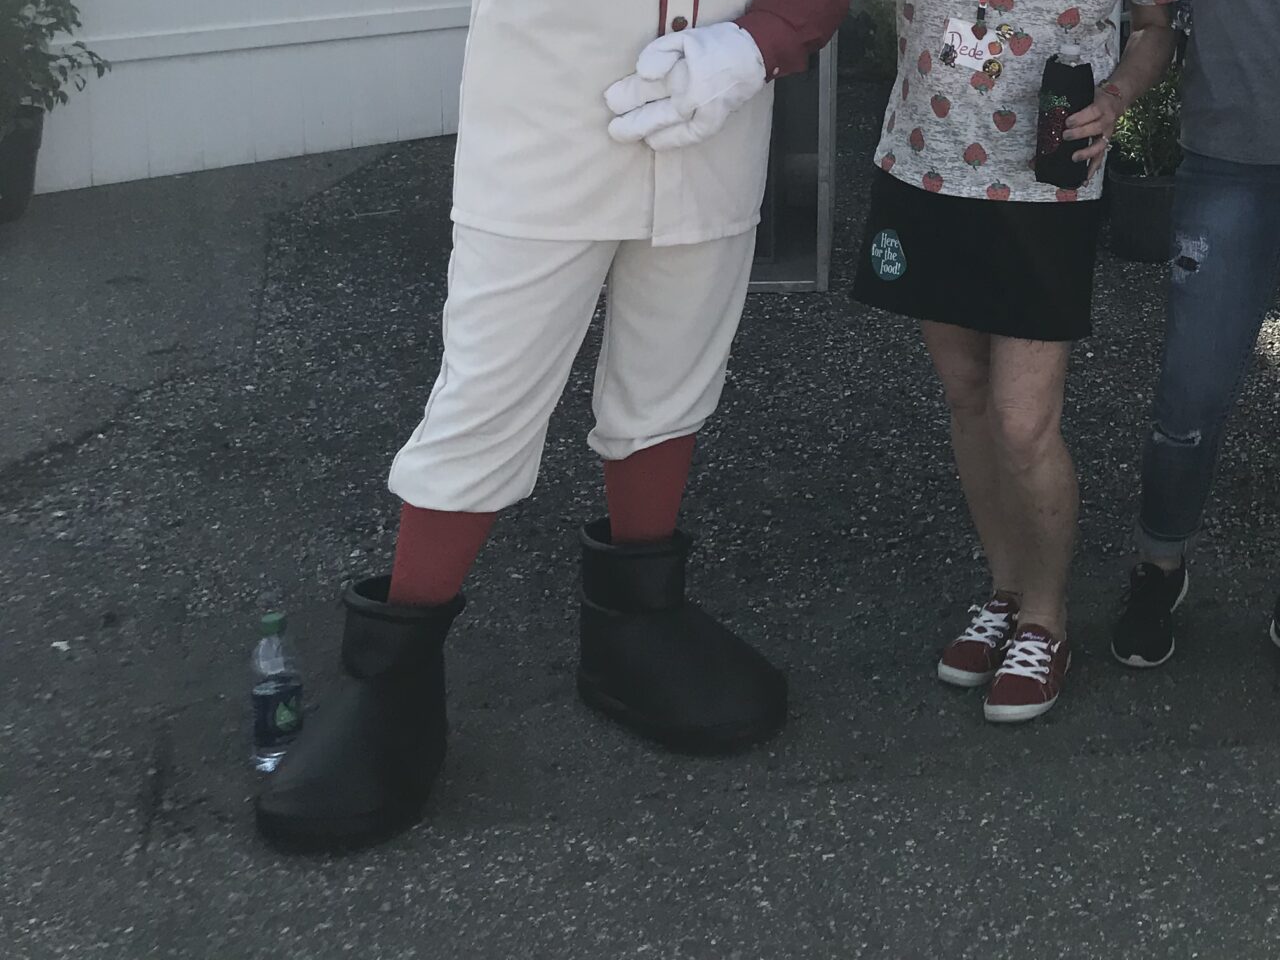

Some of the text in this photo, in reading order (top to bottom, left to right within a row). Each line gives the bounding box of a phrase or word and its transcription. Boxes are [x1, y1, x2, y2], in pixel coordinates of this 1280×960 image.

[948, 30, 984, 60] Dede
[881, 232, 899, 248] Here
[872, 243, 897, 261] for the
[880, 259, 901, 275] Food!
